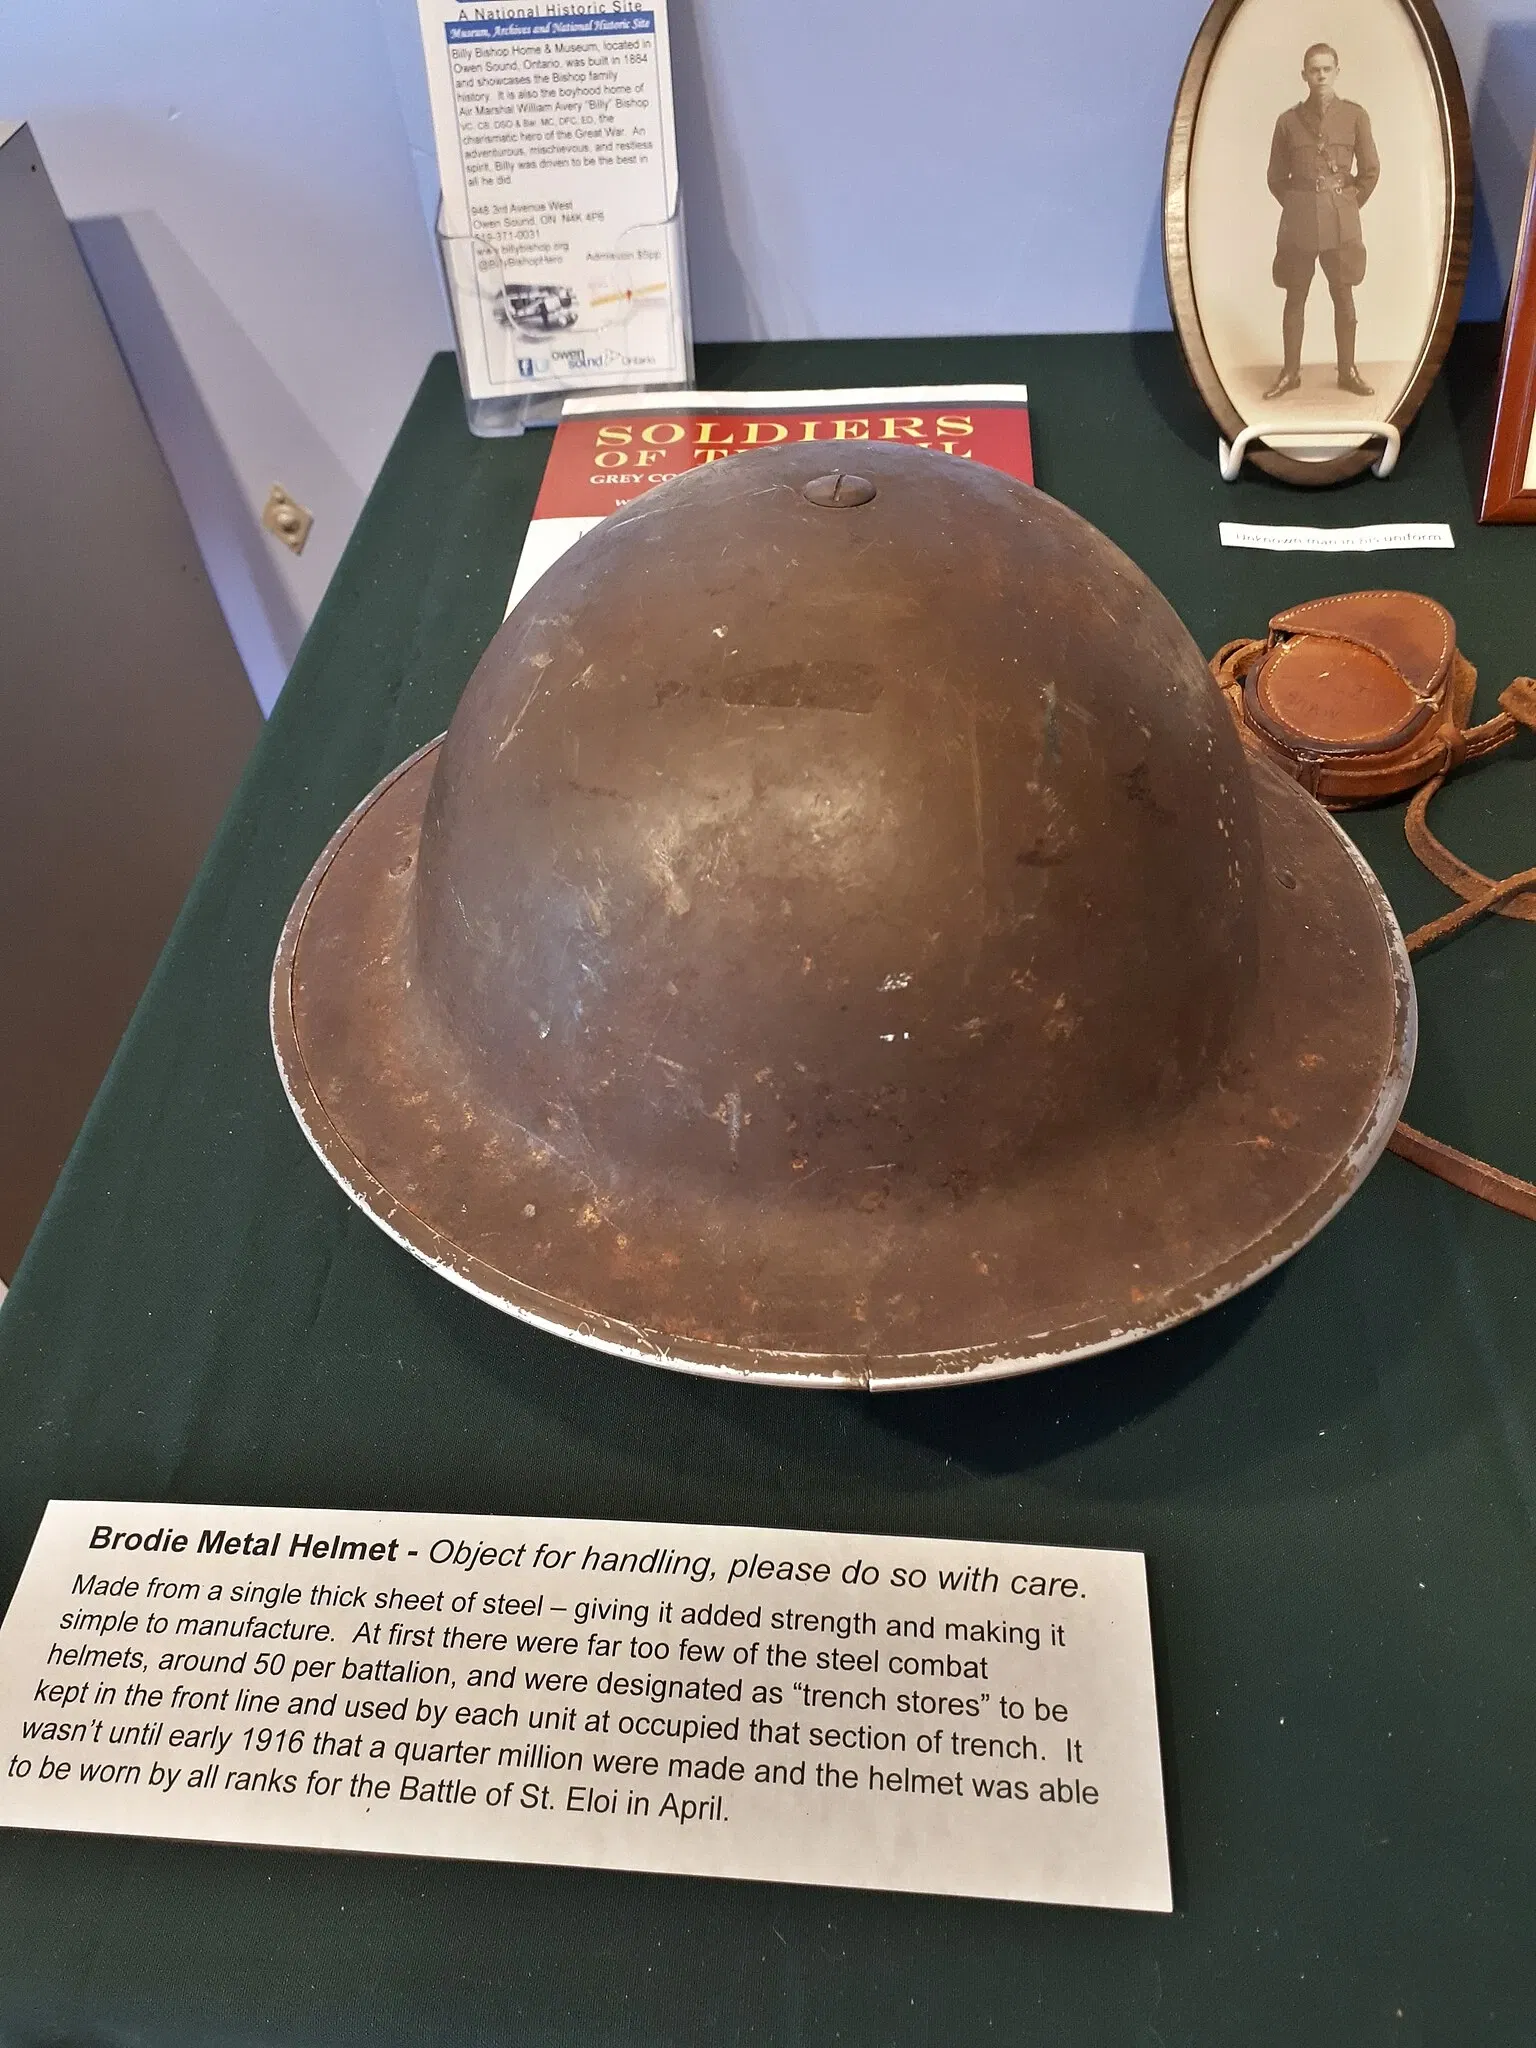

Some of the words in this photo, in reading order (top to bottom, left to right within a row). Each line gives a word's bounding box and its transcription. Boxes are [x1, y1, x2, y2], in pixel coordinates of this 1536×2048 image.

[459, 8, 468, 20] A
[474, 5, 540, 20] National
[546, 3, 605, 16] Historic
[612, 0, 642, 12] Site
[552, 19, 593, 33] National
[454, 63, 482, 73] Owen
[475, 46, 509, 58] Bishop
[512, 45, 541, 55] Home
[596, 414, 974, 447] SOLDIERS
[590, 473, 644, 484] GREY
[594, 450, 667, 468] OF
[88, 1525, 189, 1553] Brodie
[196, 1529, 282, 1557] Metal
[288, 1533, 400, 1562] Helmet
[429, 1539, 527, 1572] Object
[532, 1543, 577, 1569] for
[580, 1545, 716, 1583] handling,
[727, 1553, 831, 1584] please
[841, 1559, 880, 1586] do
[890, 1567, 927, 1589] so
[938, 1565, 999, 1593] with
[1011, 1575, 1086, 1599] care.
[71, 1574, 140, 1597] Made
[146, 1576, 201, 1600] from
[207, 1584, 223, 1601] a
[230, 1581, 302, 1609] single
[310, 1584, 368, 1608] thick
[374, 1587, 445, 1612] sheet
[451, 1591, 479, 1613] of
[482, 1593, 544, 1617] steel
[573, 1597, 649, 1628] giving
[658, 1600, 674, 1624] it
[680, 1603, 762, 1628] added
[770, 1608, 876, 1640] strength
[886, 1616, 935, 1639] and
[945, 1619, 1040, 1651] making
[1051, 1623, 1066, 1647] it
[59, 1608, 139, 1637] simple
[146, 1612, 169, 1634] to
[175, 1615, 335, 1642] manufacture.
[351, 1621, 382, 1645] At
[388, 1622, 436, 1648] first
[442, 1626, 508, 1651] there
[516, 1635, 579, 1655] were
[587, 1633, 623, 1657] far
[630, 1636, 670, 1660] too
[678, 1637, 726, 1663] few
[733, 1641, 760, 1665] of
[766, 1643, 807, 1668] the
[816, 1647, 879, 1673] steel
[888, 1653, 989, 1680] combat
[46, 1642, 148, 1673] helmets,
[158, 1651, 248, 1674] around
[253, 1652, 286, 1676] 50
[290, 1659, 336, 1683] per
[341, 1656, 456, 1689] battalion,
[466, 1665, 517, 1689] and
[524, 1672, 588, 1693] were
[596, 1671, 743, 1704] designated
[751, 1685, 783, 1705] as
[999, 1695, 1025, 1720] to
[1034, 1696, 1068, 1723] be
[33, 1678, 90, 1709] kept
[93, 1681, 117, 1705] in
[124, 1683, 163, 1708] the
[170, 1684, 230, 1711] front
[234, 1688, 280, 1714] line
[287, 1693, 338, 1717] and
[344, 1697, 409, 1721] used
[415, 1698, 449, 1729] by
[455, 1703, 519, 1728] each
[528, 1706, 577, 1731] unit
[584, 1709, 611, 1733] at
[618, 1714, 740, 1744] occupied
[749, 1718, 801, 1745] that
[808, 1725, 906, 1752] section
[916, 1729, 944, 1754] of
[950, 1731, 1046, 1761] trench.
[1066, 1737, 1084, 1764] It
[8, 1754, 32, 1778] to
[38, 1754, 71, 1780] be
[80, 1763, 141, 1785] worn
[148, 1761, 182, 1793] by
[187, 1763, 220, 1789] all
[224, 1767, 298, 1794] ranks
[306, 1769, 343, 1796] for
[349, 1772, 391, 1799] the
[399, 1775, 477, 1805] Battle
[486, 1781, 515, 1807] of
[520, 1783, 554, 1810] St.
[566, 1786, 618, 1814] Eloi
[626, 1789, 650, 1816] in
[658, 1792, 728, 1825] April.
[108, 1722, 164, 1746] until
[168, 1725, 233, 1756] early
[243, 1727, 305, 1754] 1916
[312, 1731, 363, 1758] that
[369, 1740, 386, 1759] a
[394, 1740, 492, 1767] quarter
[497, 1743, 583, 1771] million
[593, 1753, 659, 1776] were
[668, 1755, 745, 1782] made
[754, 1760, 806, 1786] and
[815, 1762, 859, 1789] the
[869, 1765, 964, 1797] helmet
[971, 1778, 1029, 1801] was
[1039, 1777, 1099, 1805] able
